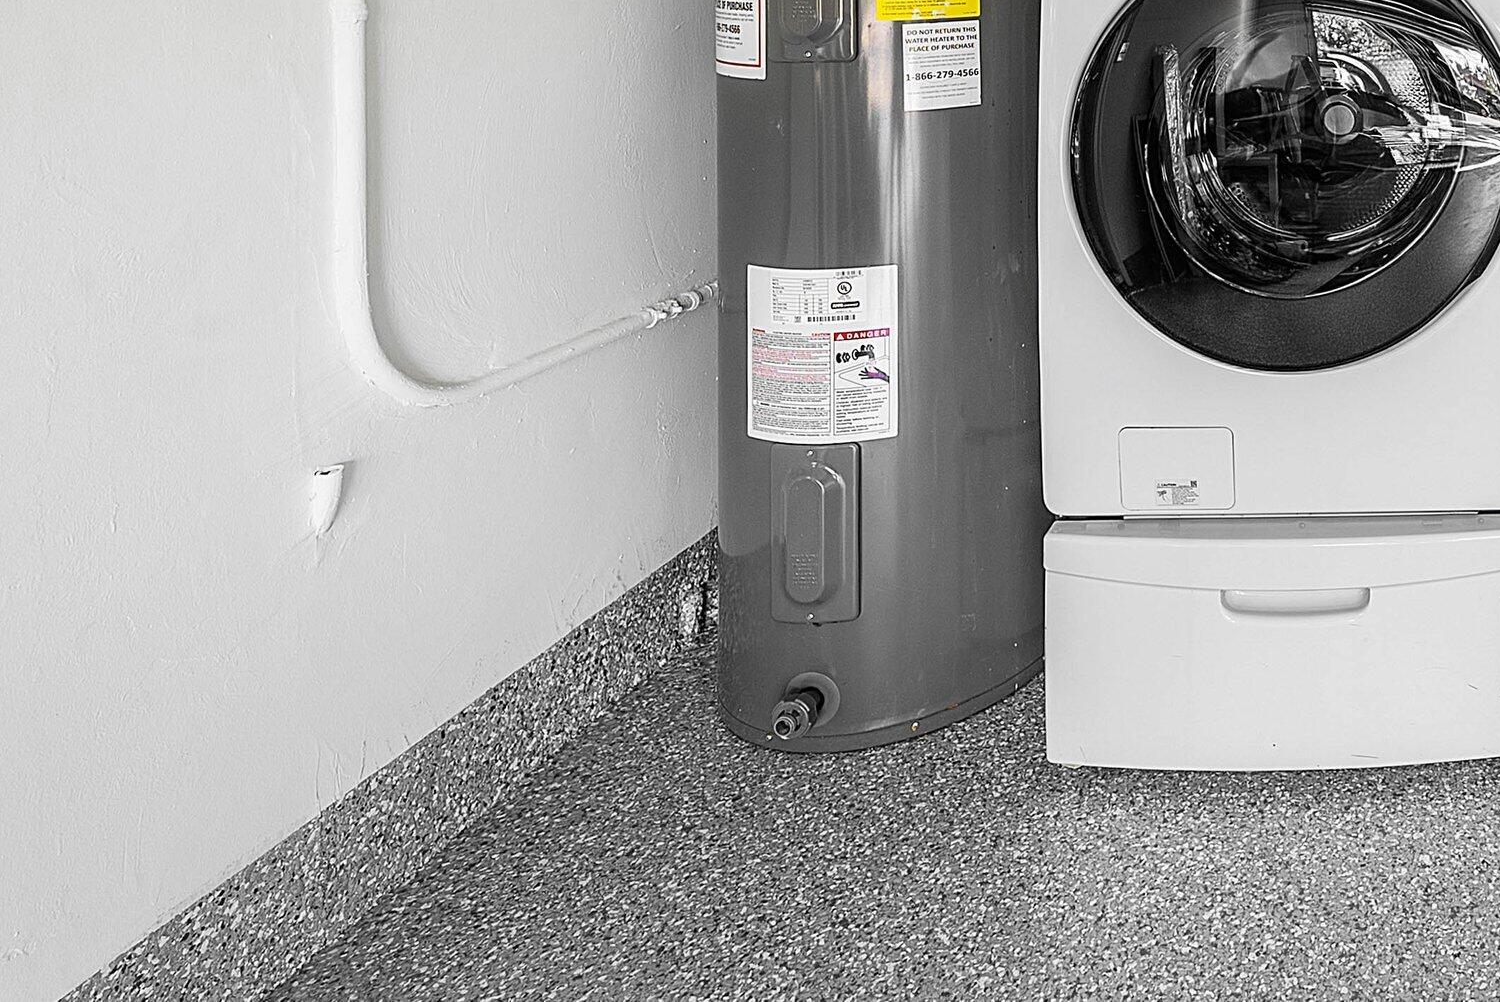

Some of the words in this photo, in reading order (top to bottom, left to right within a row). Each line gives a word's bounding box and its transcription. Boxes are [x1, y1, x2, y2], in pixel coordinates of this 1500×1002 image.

[934, 27, 962, 35] RETURN
[941, 42, 976, 51] PURCHASE
[906, 67, 980, 82] 1-866-279-4566
[846, 329, 887, 341] DANGER
